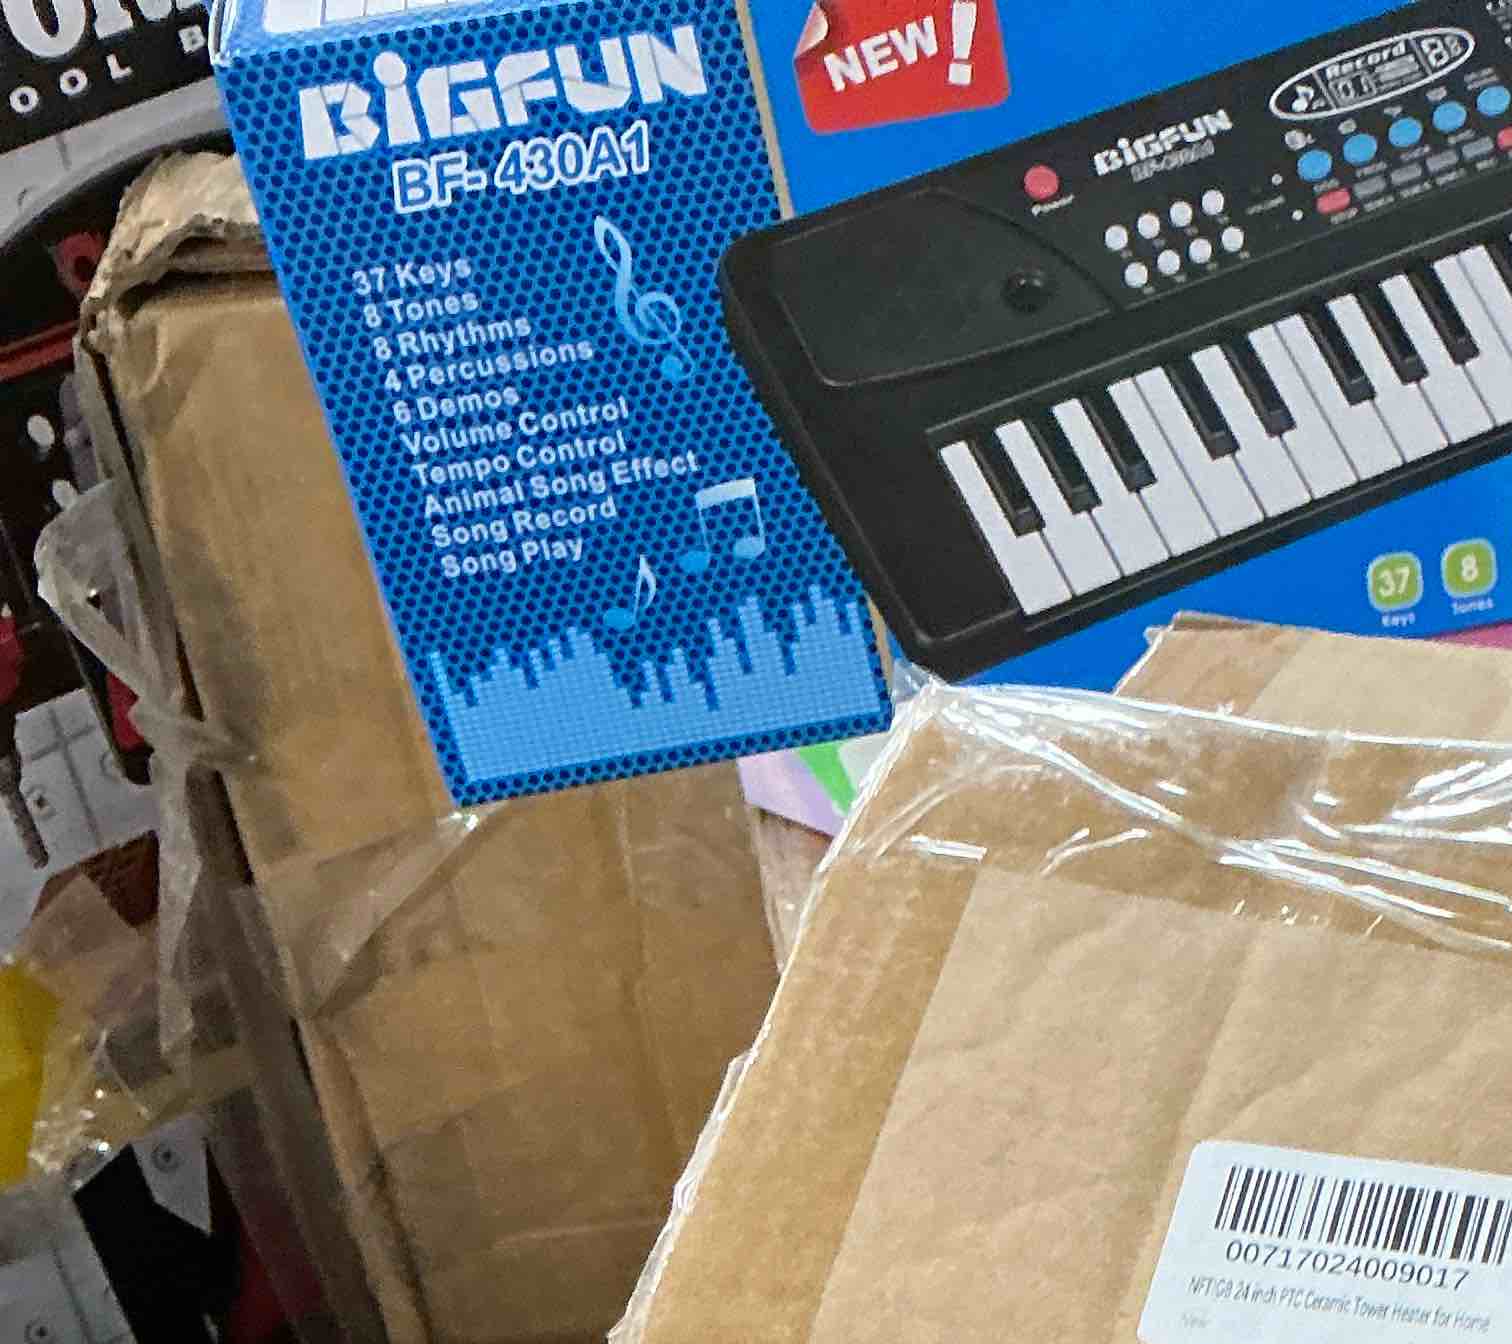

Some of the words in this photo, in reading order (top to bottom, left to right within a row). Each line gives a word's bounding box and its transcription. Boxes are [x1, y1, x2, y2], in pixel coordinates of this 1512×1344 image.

[823, 0, 977, 92] NEW!
[352, 267, 385, 295] 37
[395, 258, 471, 289] Keys
[363, 303, 381, 328] 8
[387, 292, 479, 323] Tones
[373, 336, 392, 361] 8
[398, 317, 531, 356] Rhythms
[384, 368, 402, 392] 4
[407, 340, 594, 389] Percussions
[393, 400, 411, 425] 6
[416, 386, 520, 421] Demos
[401, 420, 512, 456] Volume
[518, 396, 629, 436] Control
[412, 454, 511, 487] Tempo
[516, 430, 626, 468] Control
[424, 480, 525, 518] Animal
[530, 468, 606, 500] Song
[612, 450, 701, 486] Effect
[431, 516, 509, 548] Song
[512, 495, 617, 534] Record
[441, 550, 517, 579] Song
[521, 537, 584, 565] Play
[1460, 553, 1479, 582] 8
[1378, 567, 1410, 598] 37
[1225, 1239, 1469, 1292] 00717024009017
[1279, 1285, 1304, 1307] PTC
[1353, 1297, 1390, 1320] Tower
